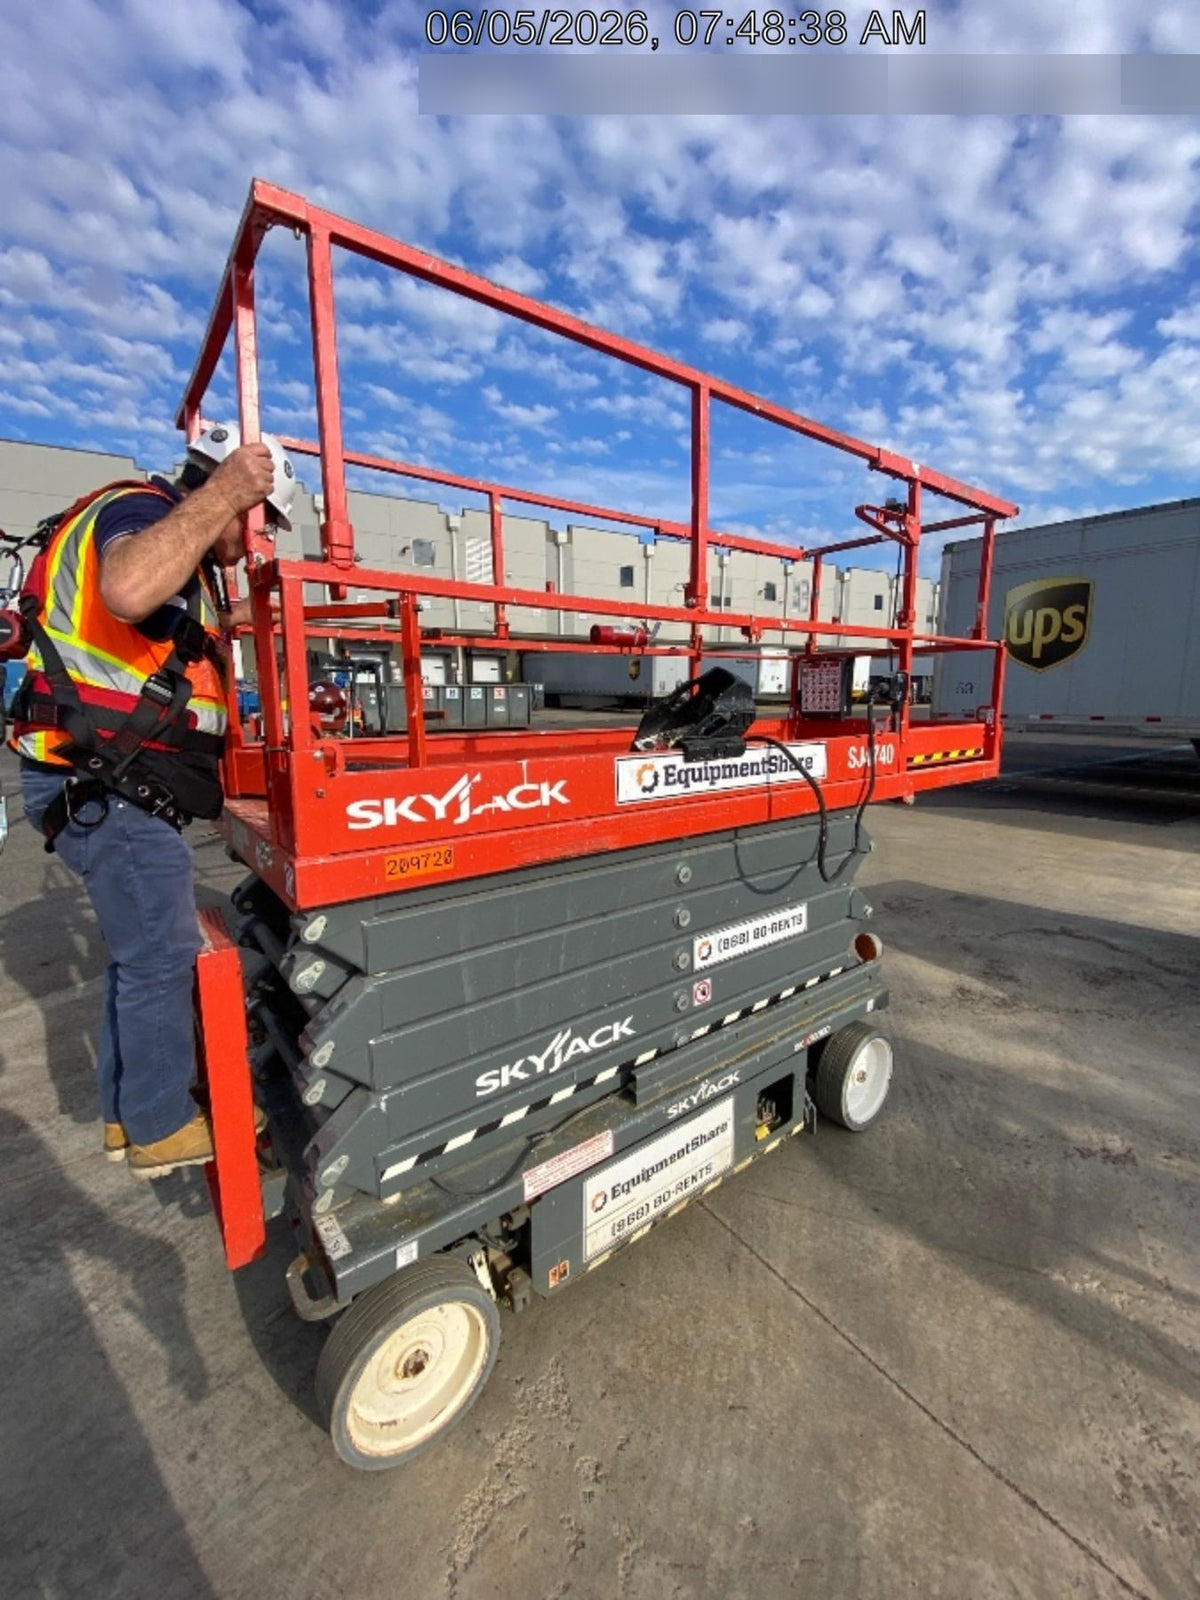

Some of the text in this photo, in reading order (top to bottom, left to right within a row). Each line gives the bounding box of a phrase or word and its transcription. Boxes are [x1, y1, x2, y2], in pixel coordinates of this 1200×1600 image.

[663, 754, 813, 788] EquipmentShare
[475, 1015, 636, 1098] SKYJACK
[611, 1120, 729, 1201] EquipmentShare
